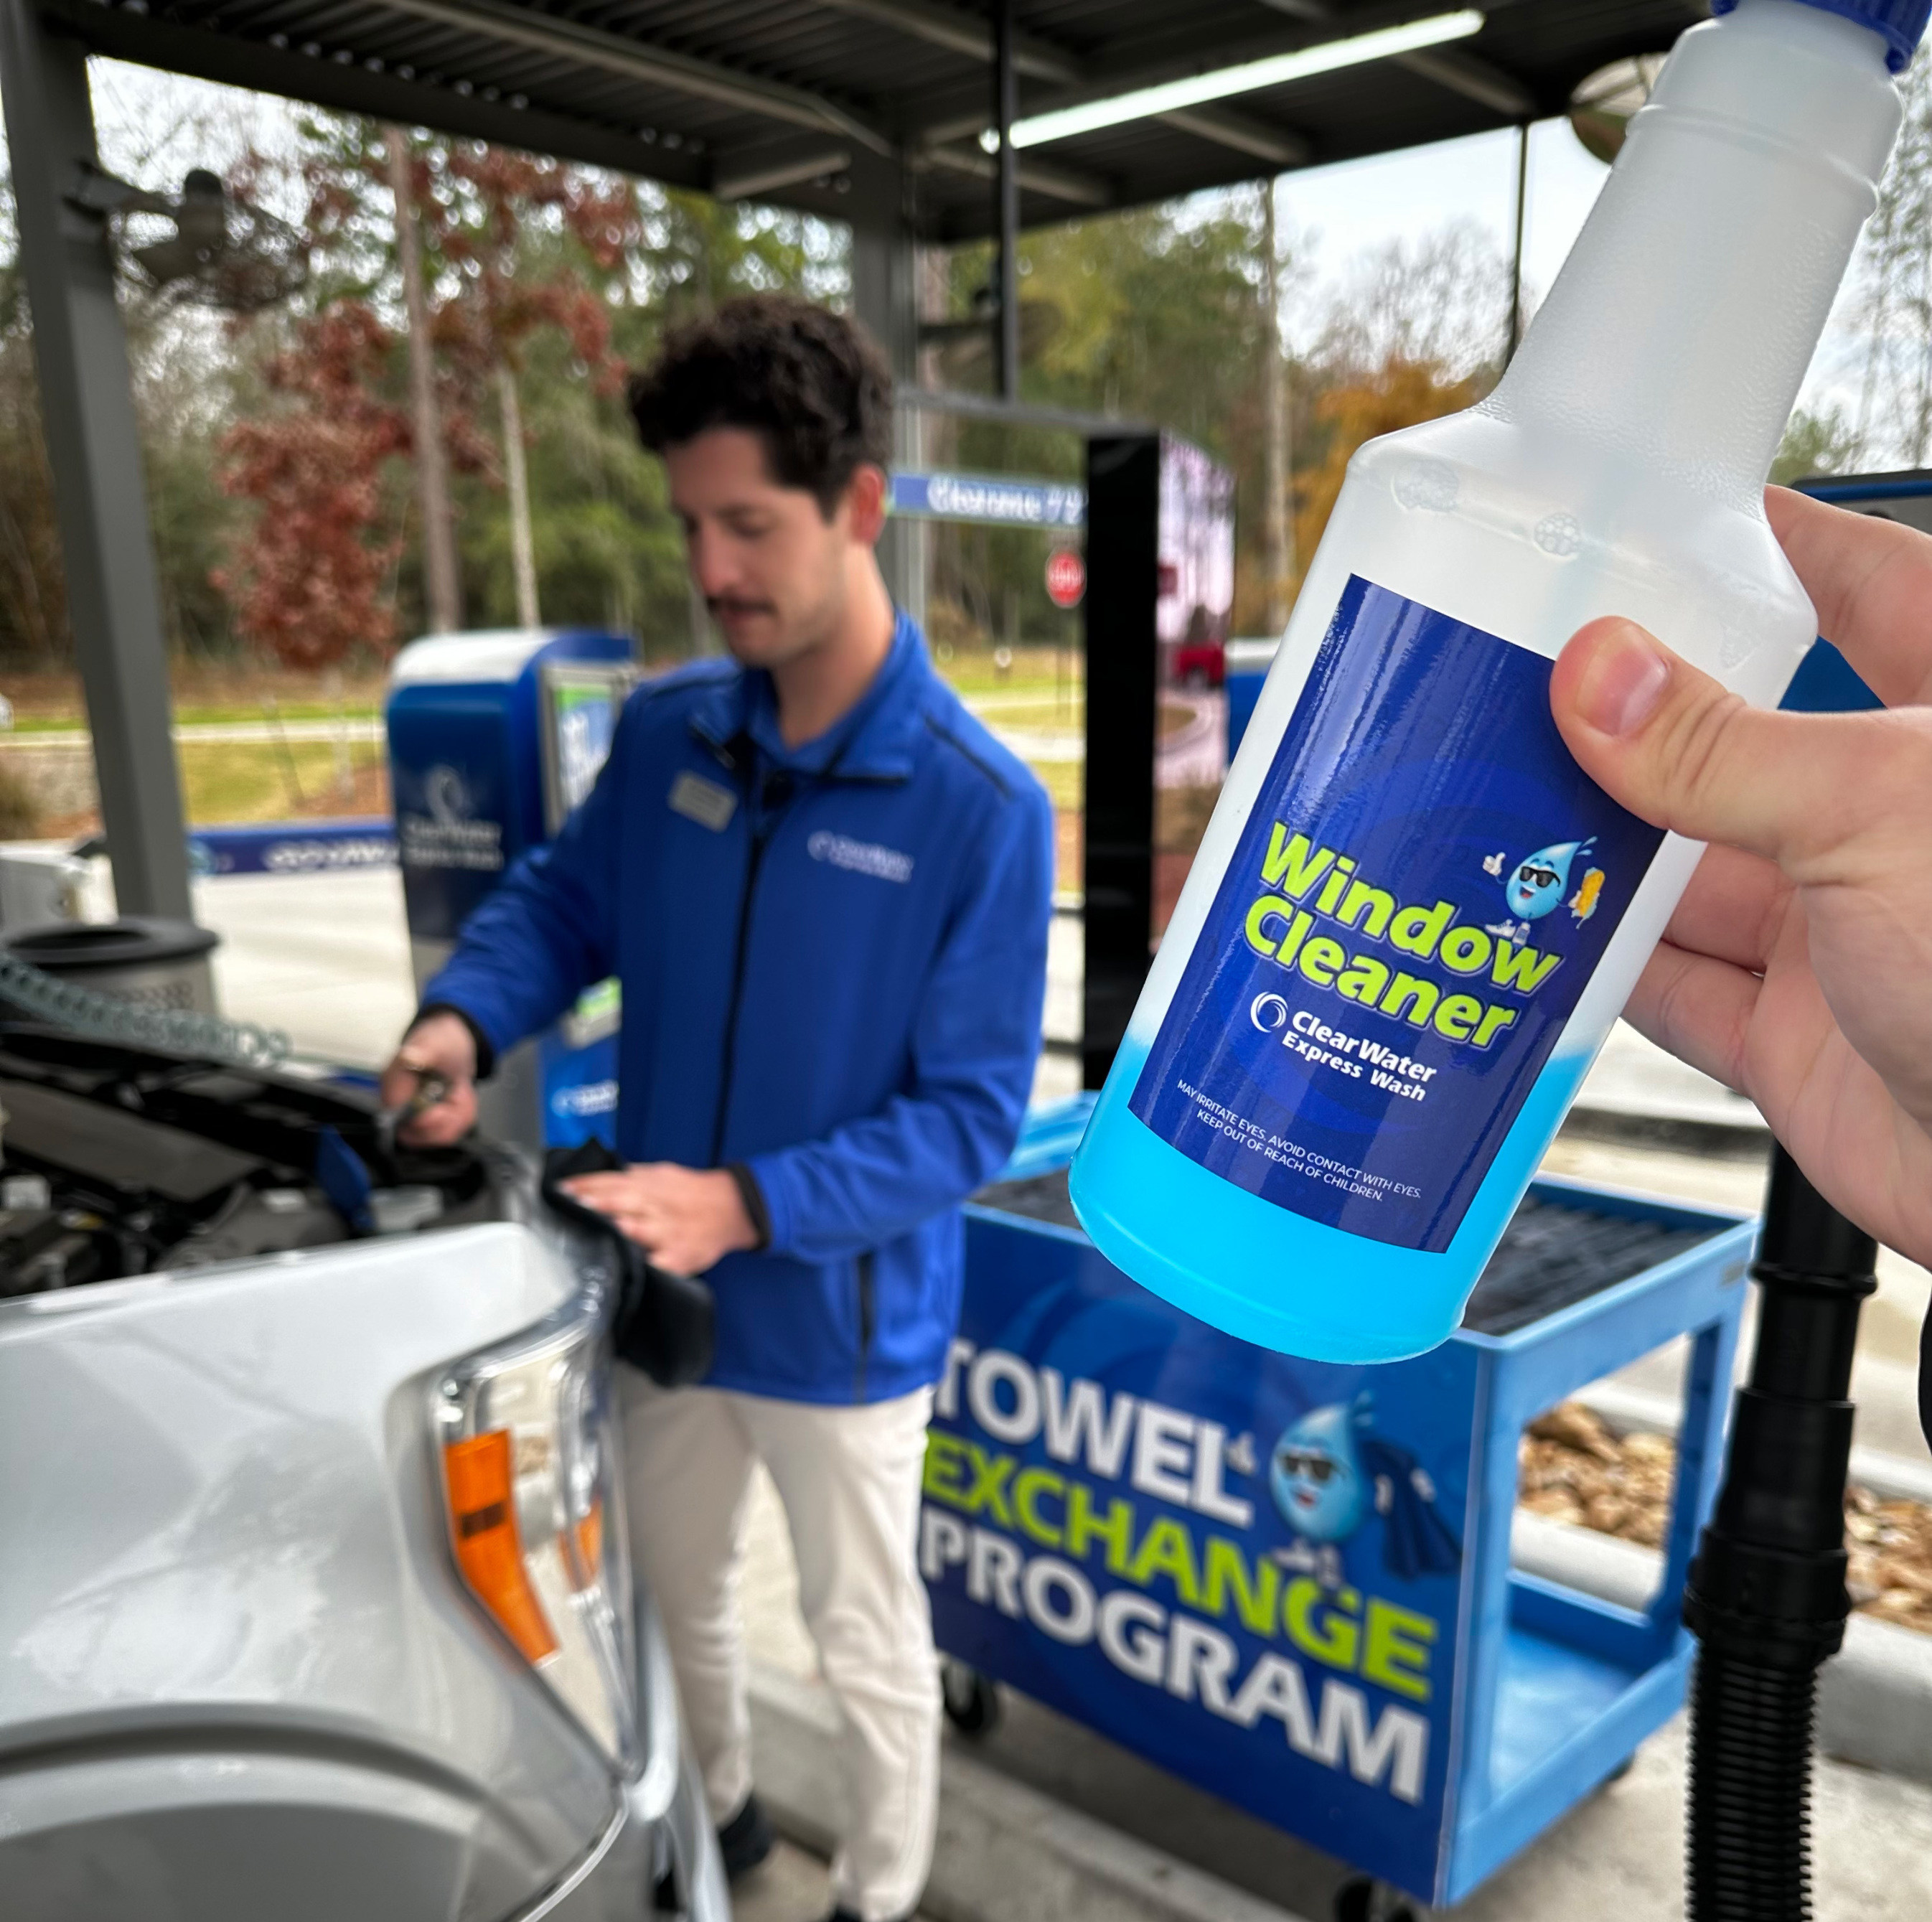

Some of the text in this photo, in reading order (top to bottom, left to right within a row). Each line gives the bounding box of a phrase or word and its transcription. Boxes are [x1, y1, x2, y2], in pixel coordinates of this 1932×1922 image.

[1245, 894, 1517, 1049] Cleaner
[1260, 820, 1565, 995] Window
[1282, 1030, 1427, 1102] Express Wash
[1292, 1011, 1437, 1082] ClearWater
[1177, 1079, 1422, 1199] MAY IRRITATE EYES. AVOID CONTACT WITH EYES.
[1196, 1109, 1383, 1202] KEEP OUT OF REACH OF CHILDREN.
[935, 1336, 1254, 1529] TOWEL
[923, 1427, 1437, 1704] EXCHANGE
[919, 1504, 1430, 1806] PROGRAM
